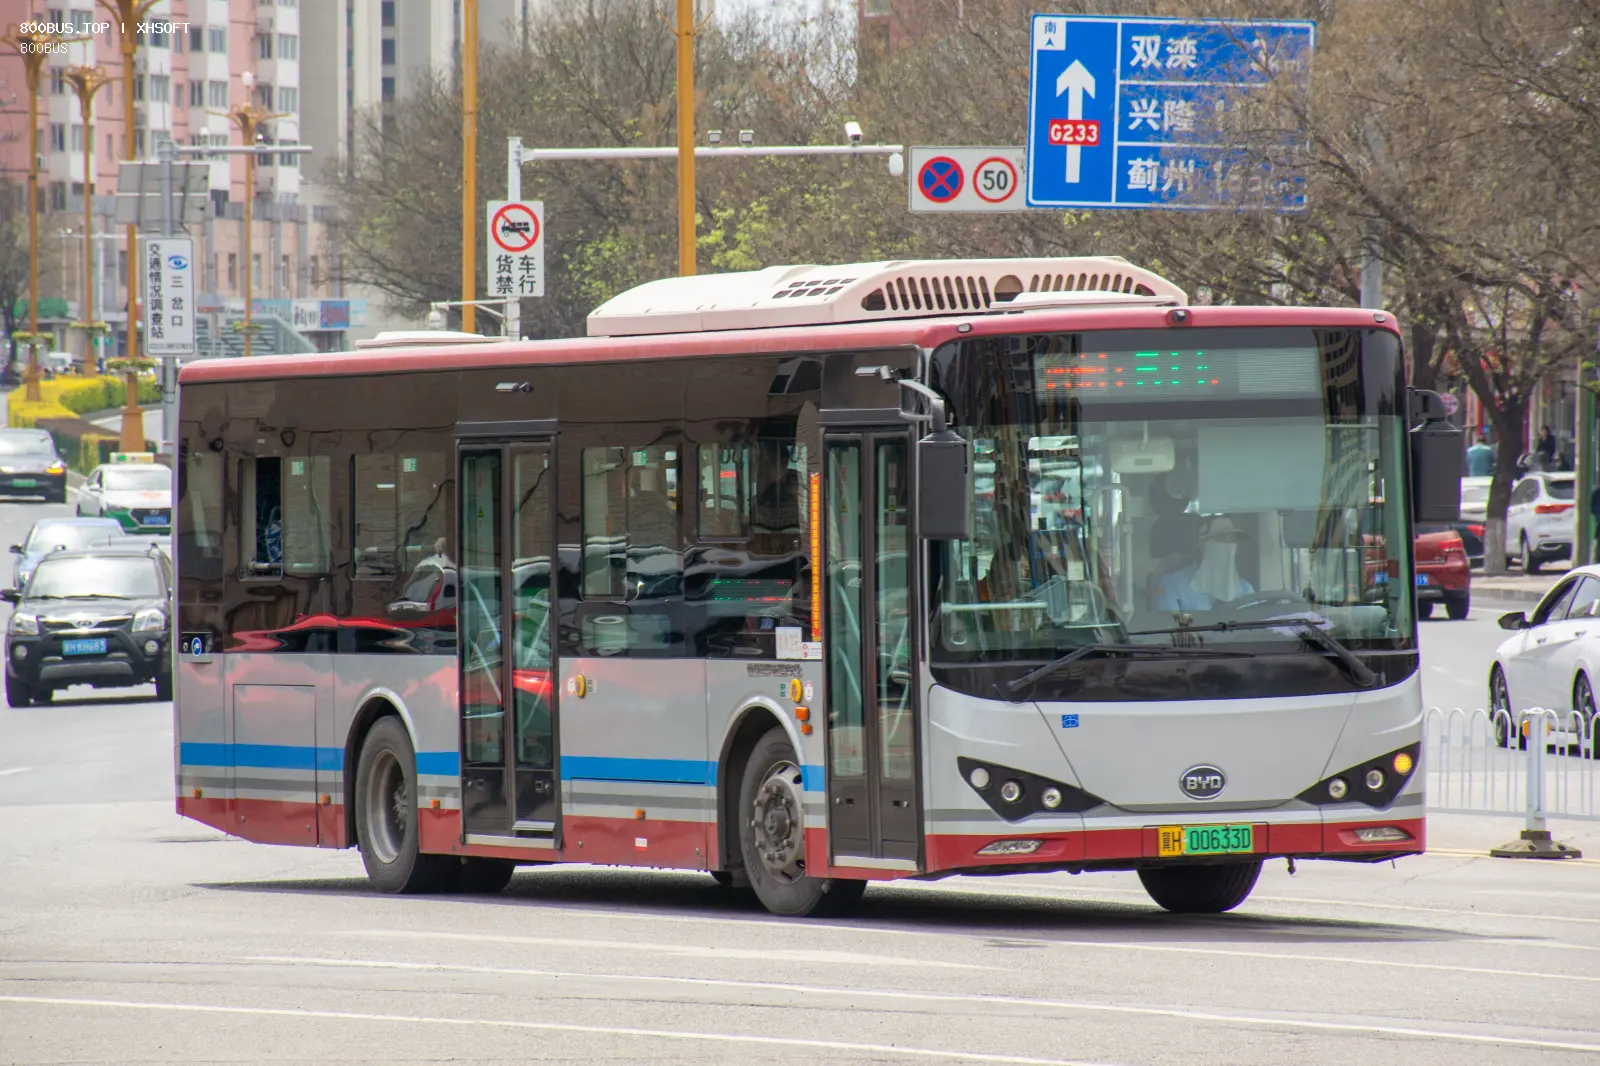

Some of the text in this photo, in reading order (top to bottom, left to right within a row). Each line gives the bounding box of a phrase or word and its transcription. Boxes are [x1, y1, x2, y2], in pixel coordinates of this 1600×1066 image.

[1044, 20, 1057, 34] 南
[1130, 35, 1197, 69] 双滦
[1128, 98, 1196, 132] 兴隆
[1050, 123, 1098, 143] G233
[983, 170, 1008, 190] 50
[1127, 157, 1195, 192] 蓟州
[496, 254, 536, 274] 货车
[148, 243, 164, 339] 交通情况调查站
[496, 274, 536, 294] 禁行
[170, 276, 185, 327] 三岔口
[1186, 775, 1222, 790] BYD
